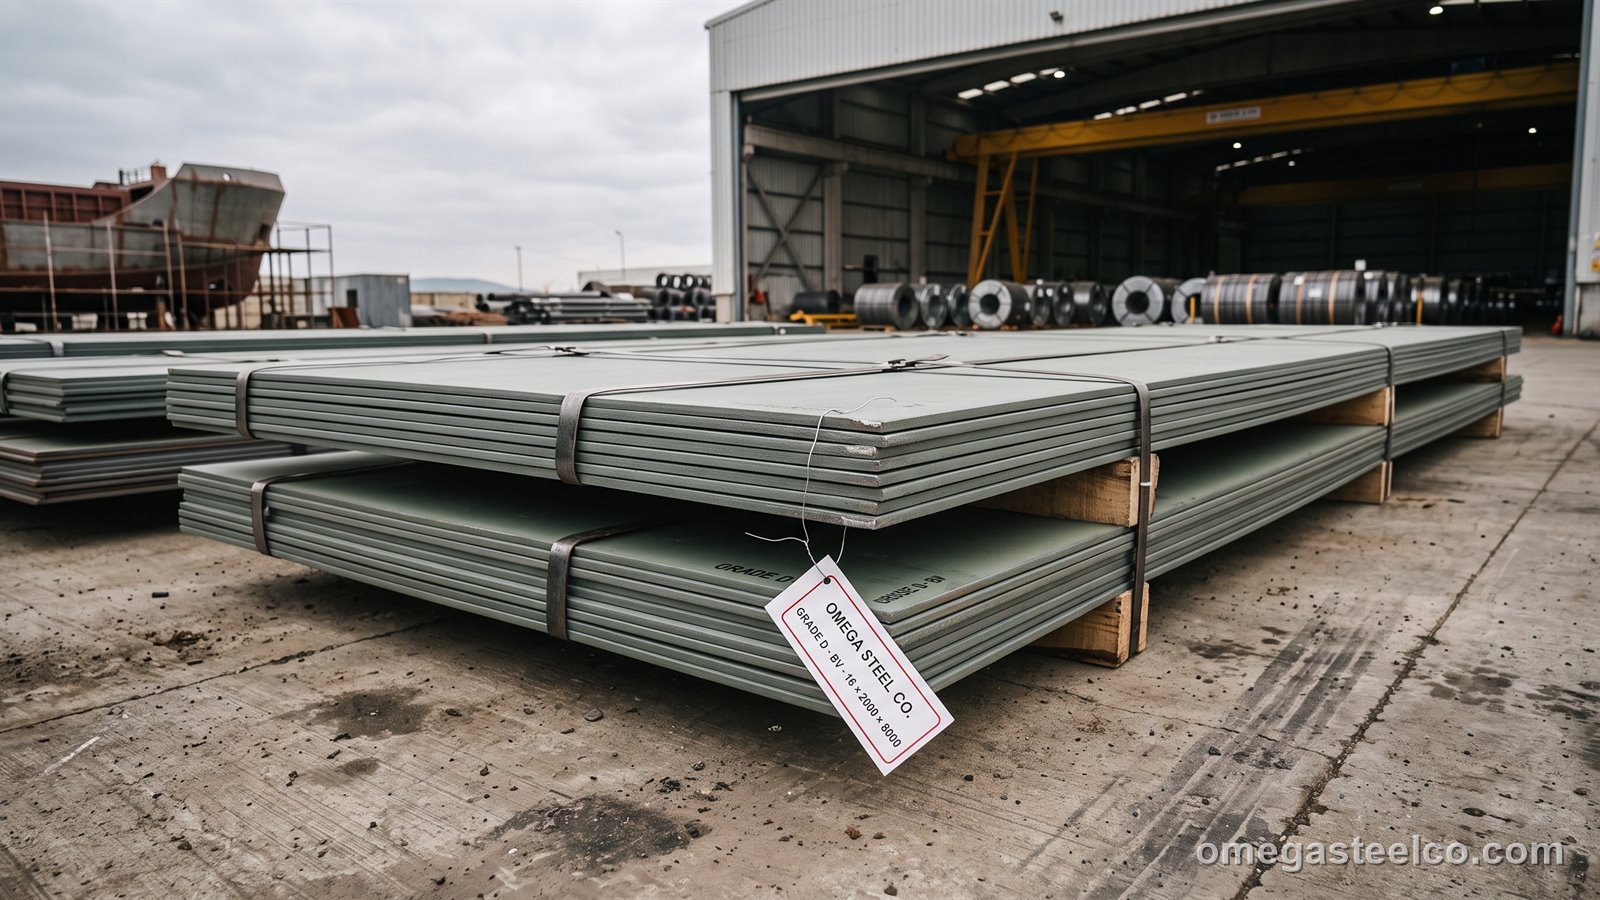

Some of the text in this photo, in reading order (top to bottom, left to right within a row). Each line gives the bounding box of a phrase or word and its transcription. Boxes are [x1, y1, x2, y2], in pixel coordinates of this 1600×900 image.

[714, 563, 779, 579] GRADE
[796, 607, 824, 641] GRADE
[819, 640, 829, 649] D
[830, 653, 844, 667] BV
[845, 673, 857, 686] 16
[858, 692, 879, 717] 2000
[881, 723, 902, 747] 8000
[826, 602, 913, 718] OMEGA STEEL CO.
